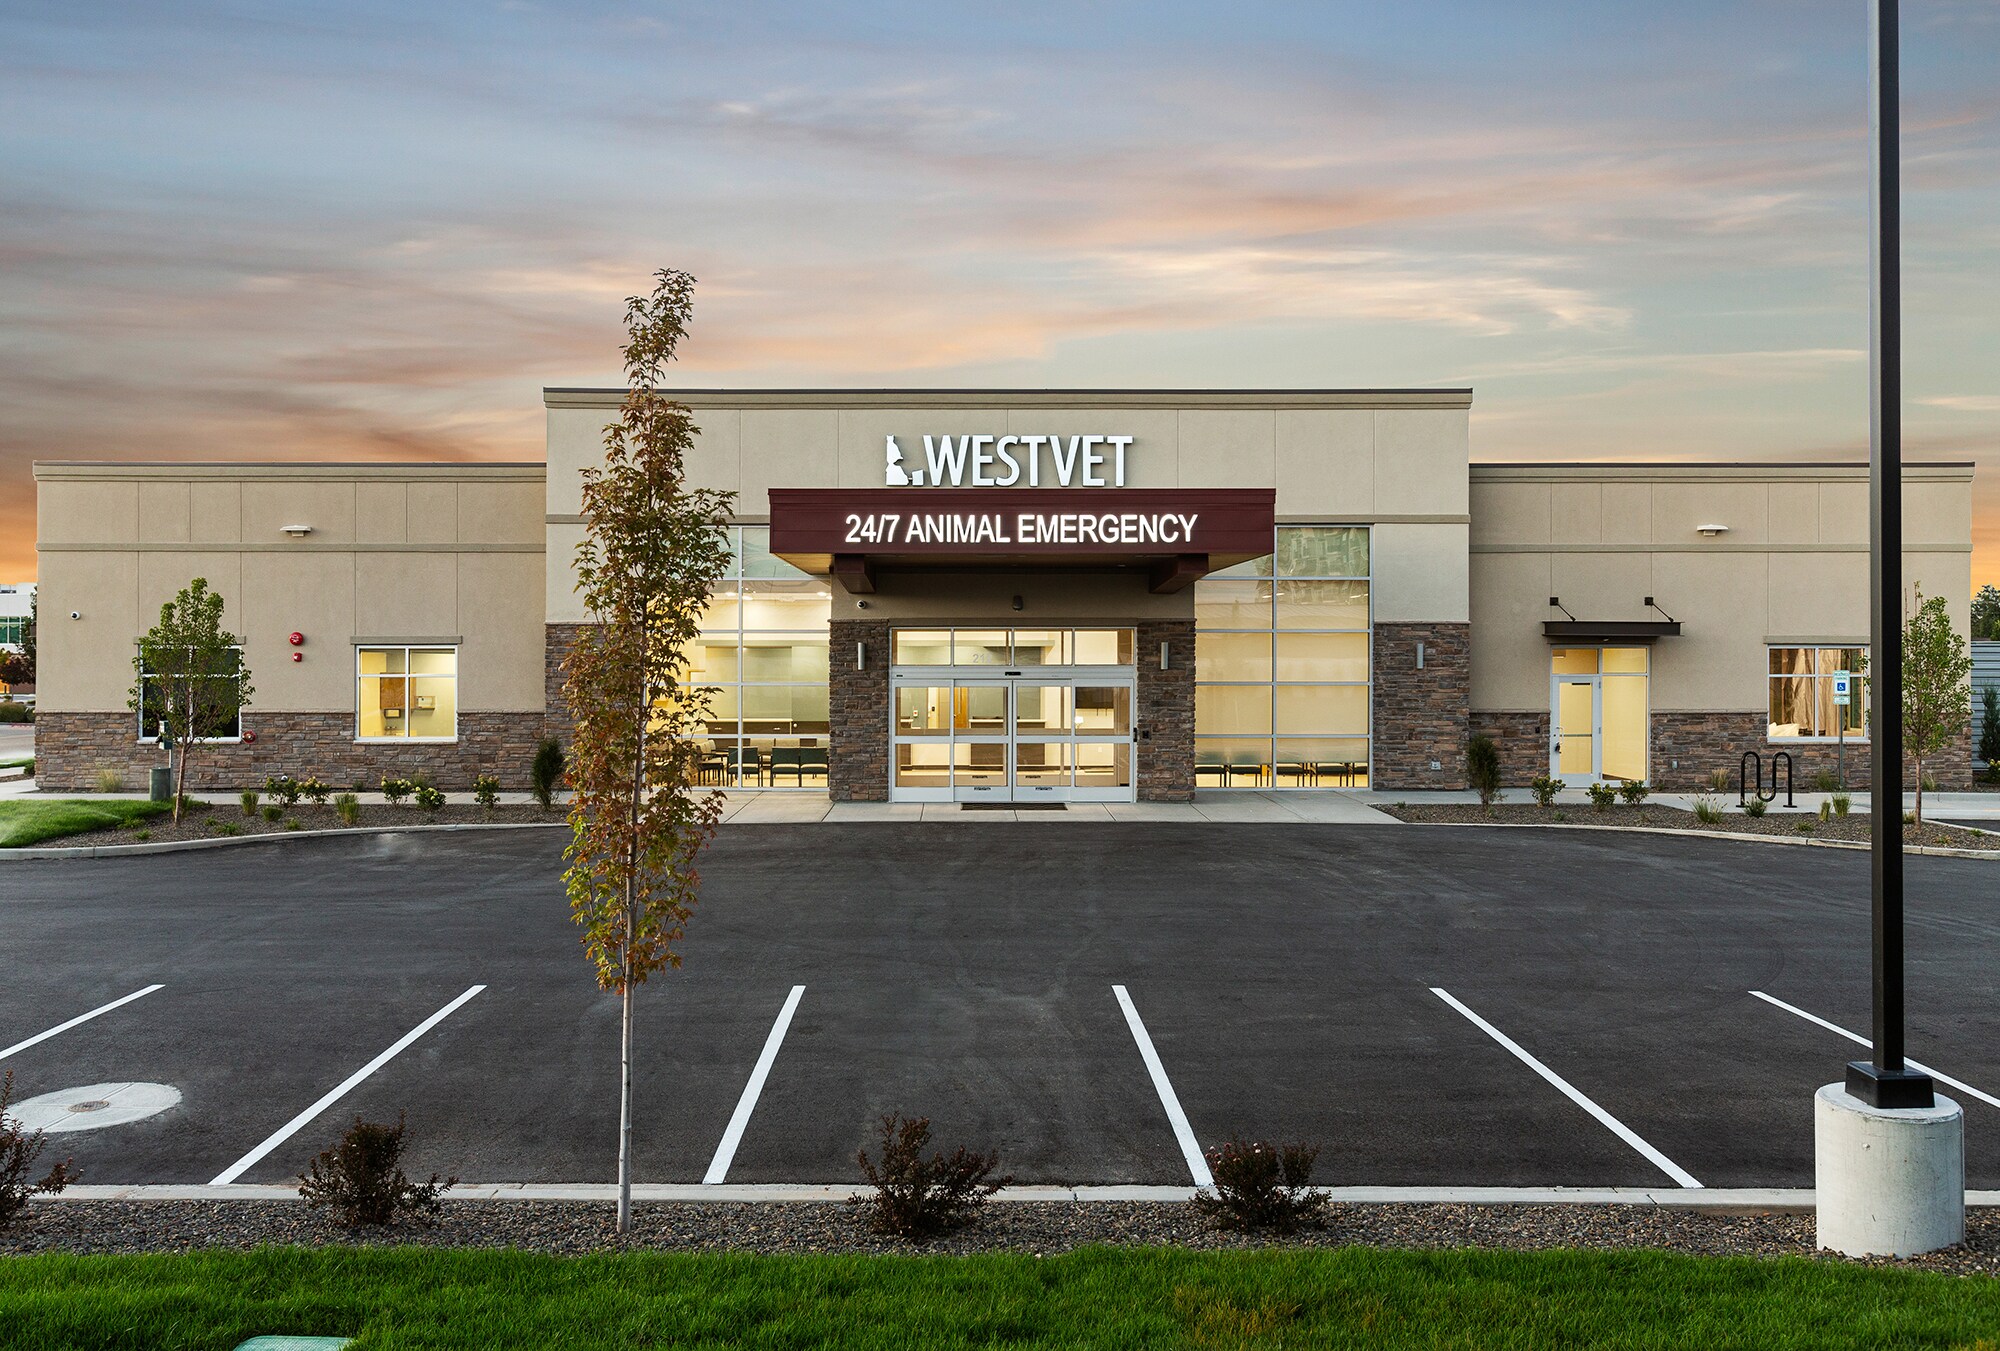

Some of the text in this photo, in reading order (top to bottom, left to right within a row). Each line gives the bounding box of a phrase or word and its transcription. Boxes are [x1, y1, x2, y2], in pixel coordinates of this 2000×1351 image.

[923, 434, 1133, 487] WESTVET
[845, 514, 1199, 543] 24/7 ANIMAL EMERGENCY
